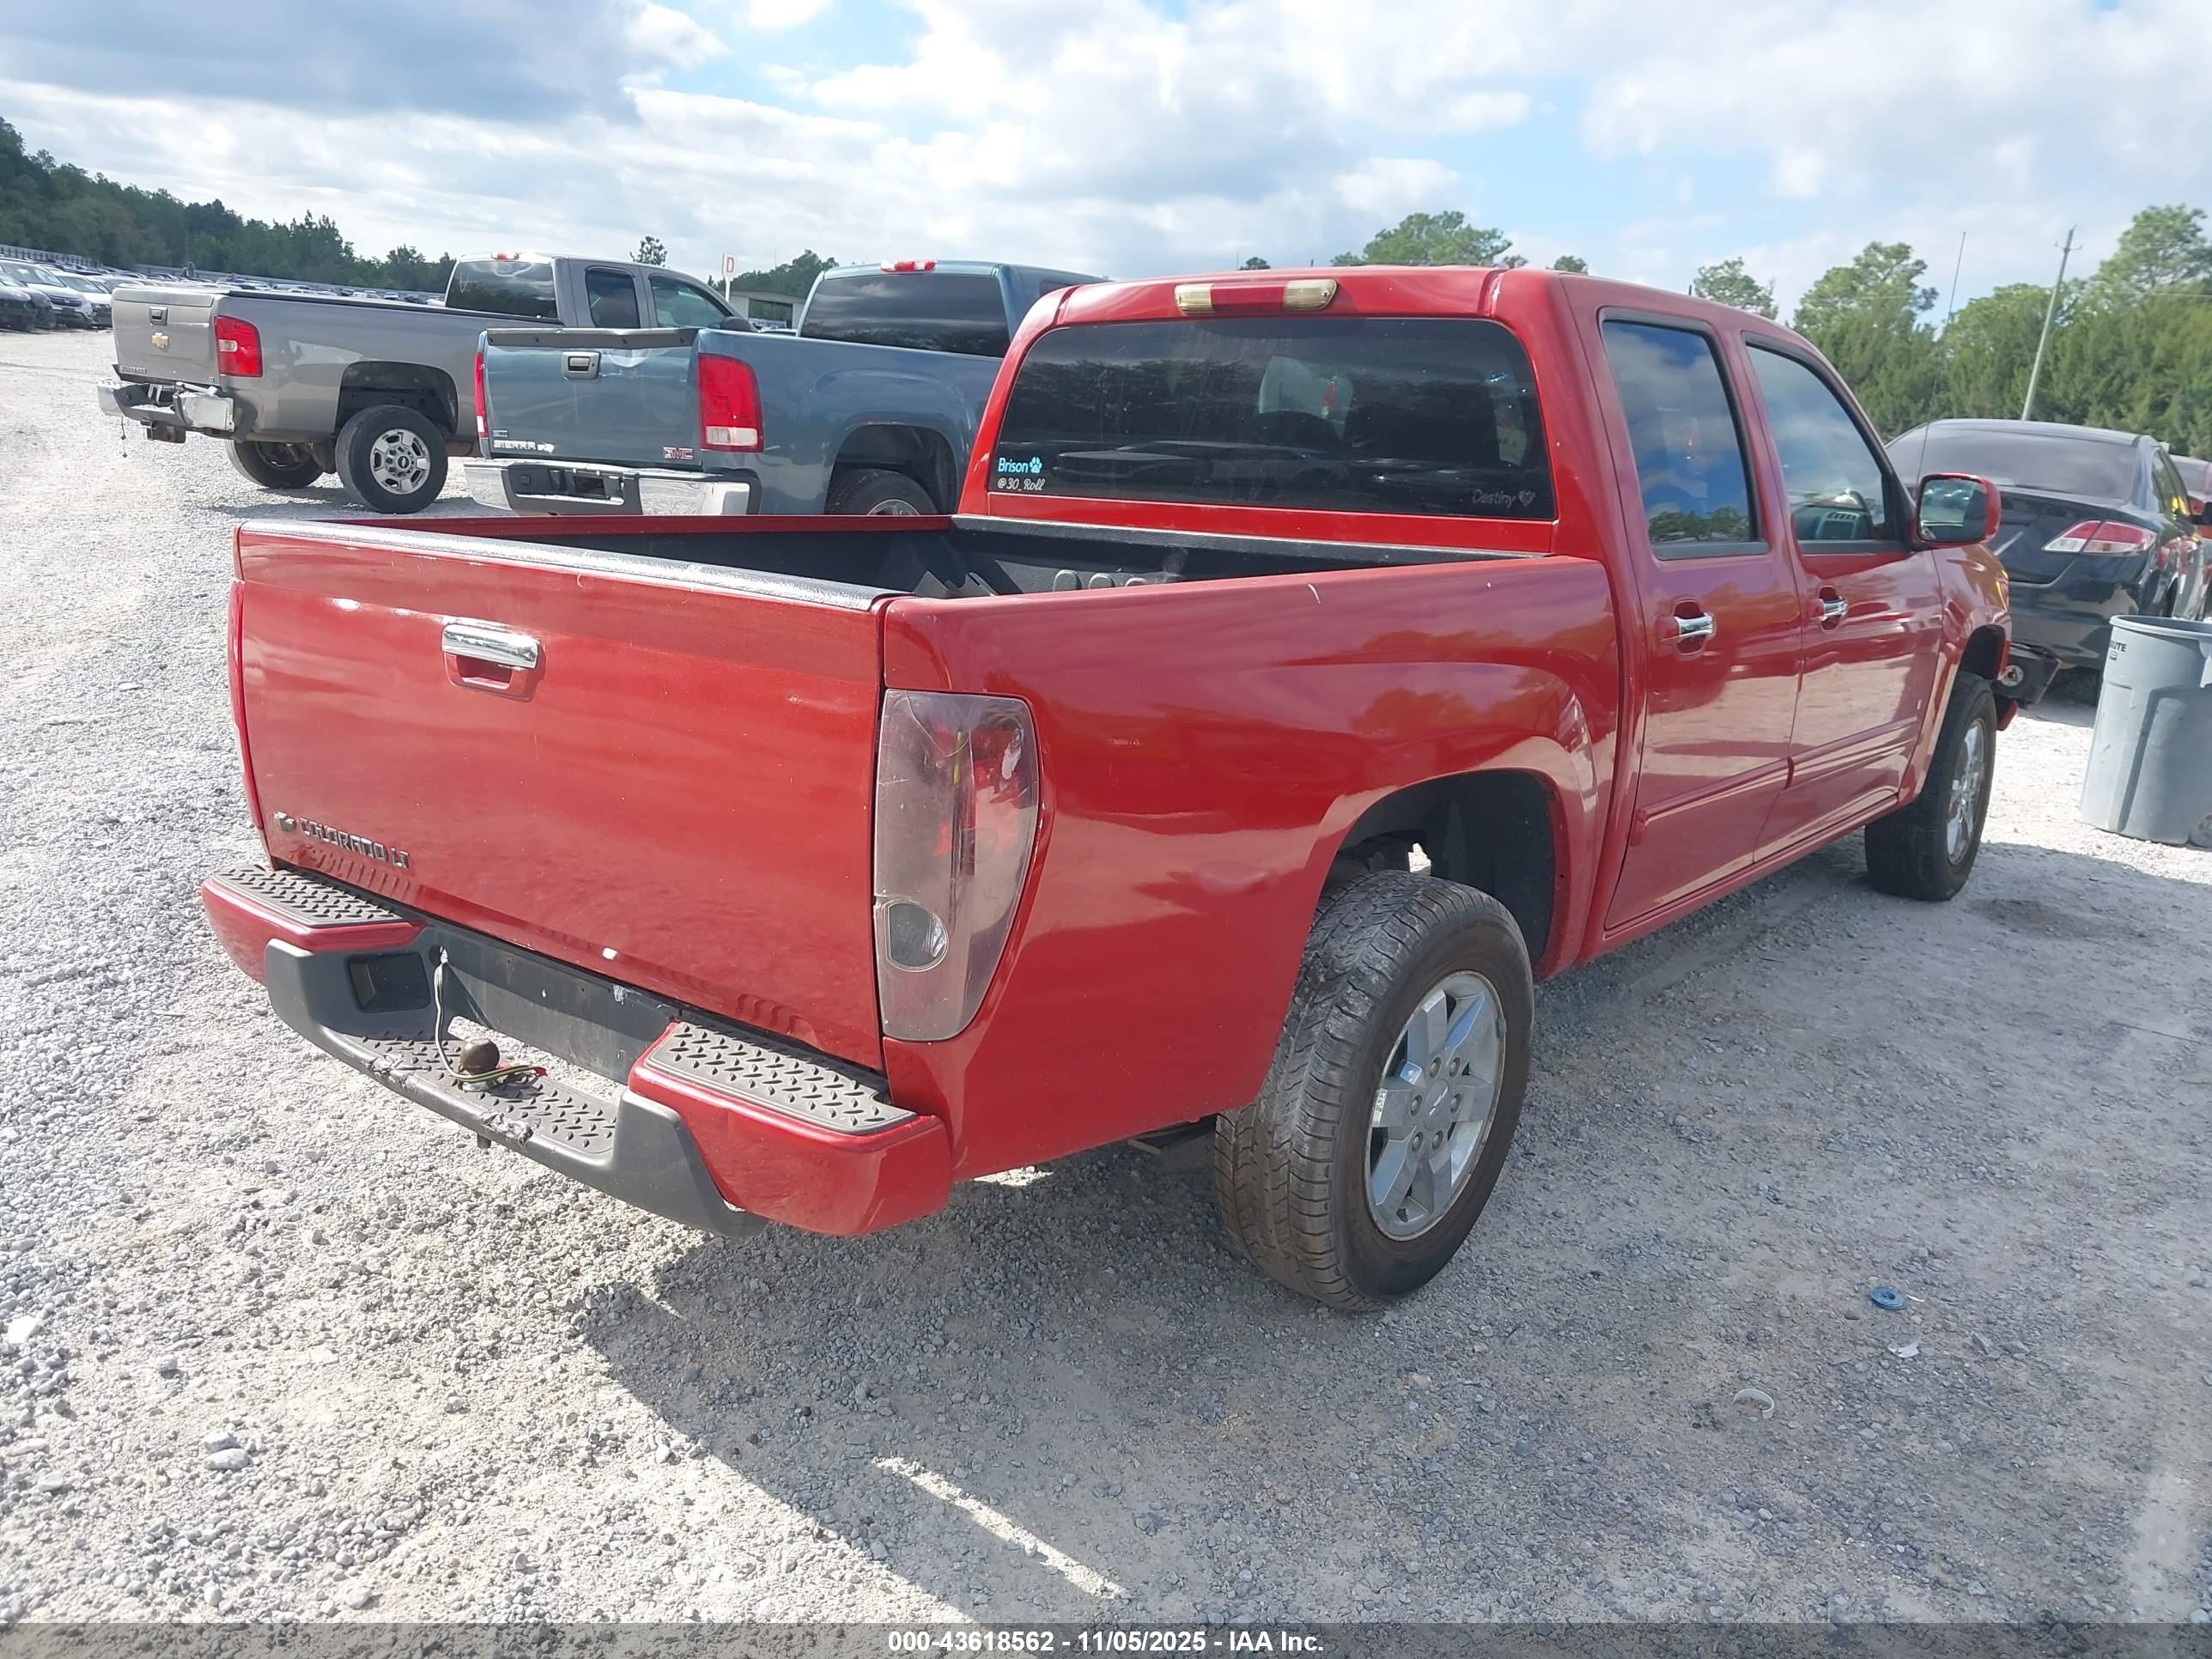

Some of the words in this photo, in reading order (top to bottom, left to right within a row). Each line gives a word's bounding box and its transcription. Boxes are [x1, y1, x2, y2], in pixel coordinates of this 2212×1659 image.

[726, 256, 735, 273] D
[663, 447, 694, 460] GMC
[998, 457, 1029, 473] Brison
[1472, 489, 1516, 507] Destiny
[299, 817, 388, 863] COLORADO
[391, 848, 410, 869] LT
